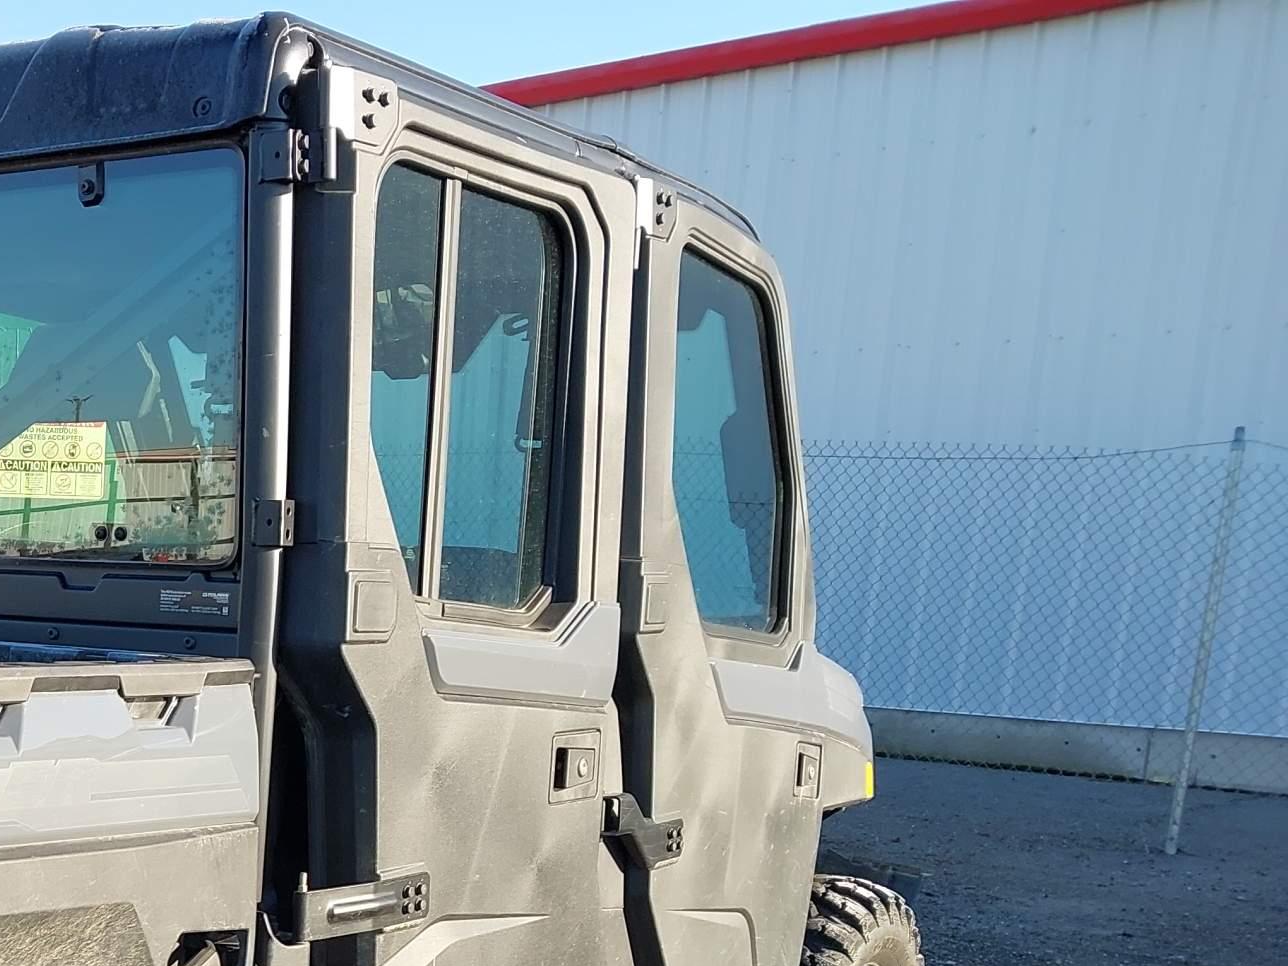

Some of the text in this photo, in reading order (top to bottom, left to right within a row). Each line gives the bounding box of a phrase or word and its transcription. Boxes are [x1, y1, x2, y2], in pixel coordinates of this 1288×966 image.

[48, 434, 84, 443] ACCEPTED
[5, 461, 102, 473] CAUTION CAUTION
